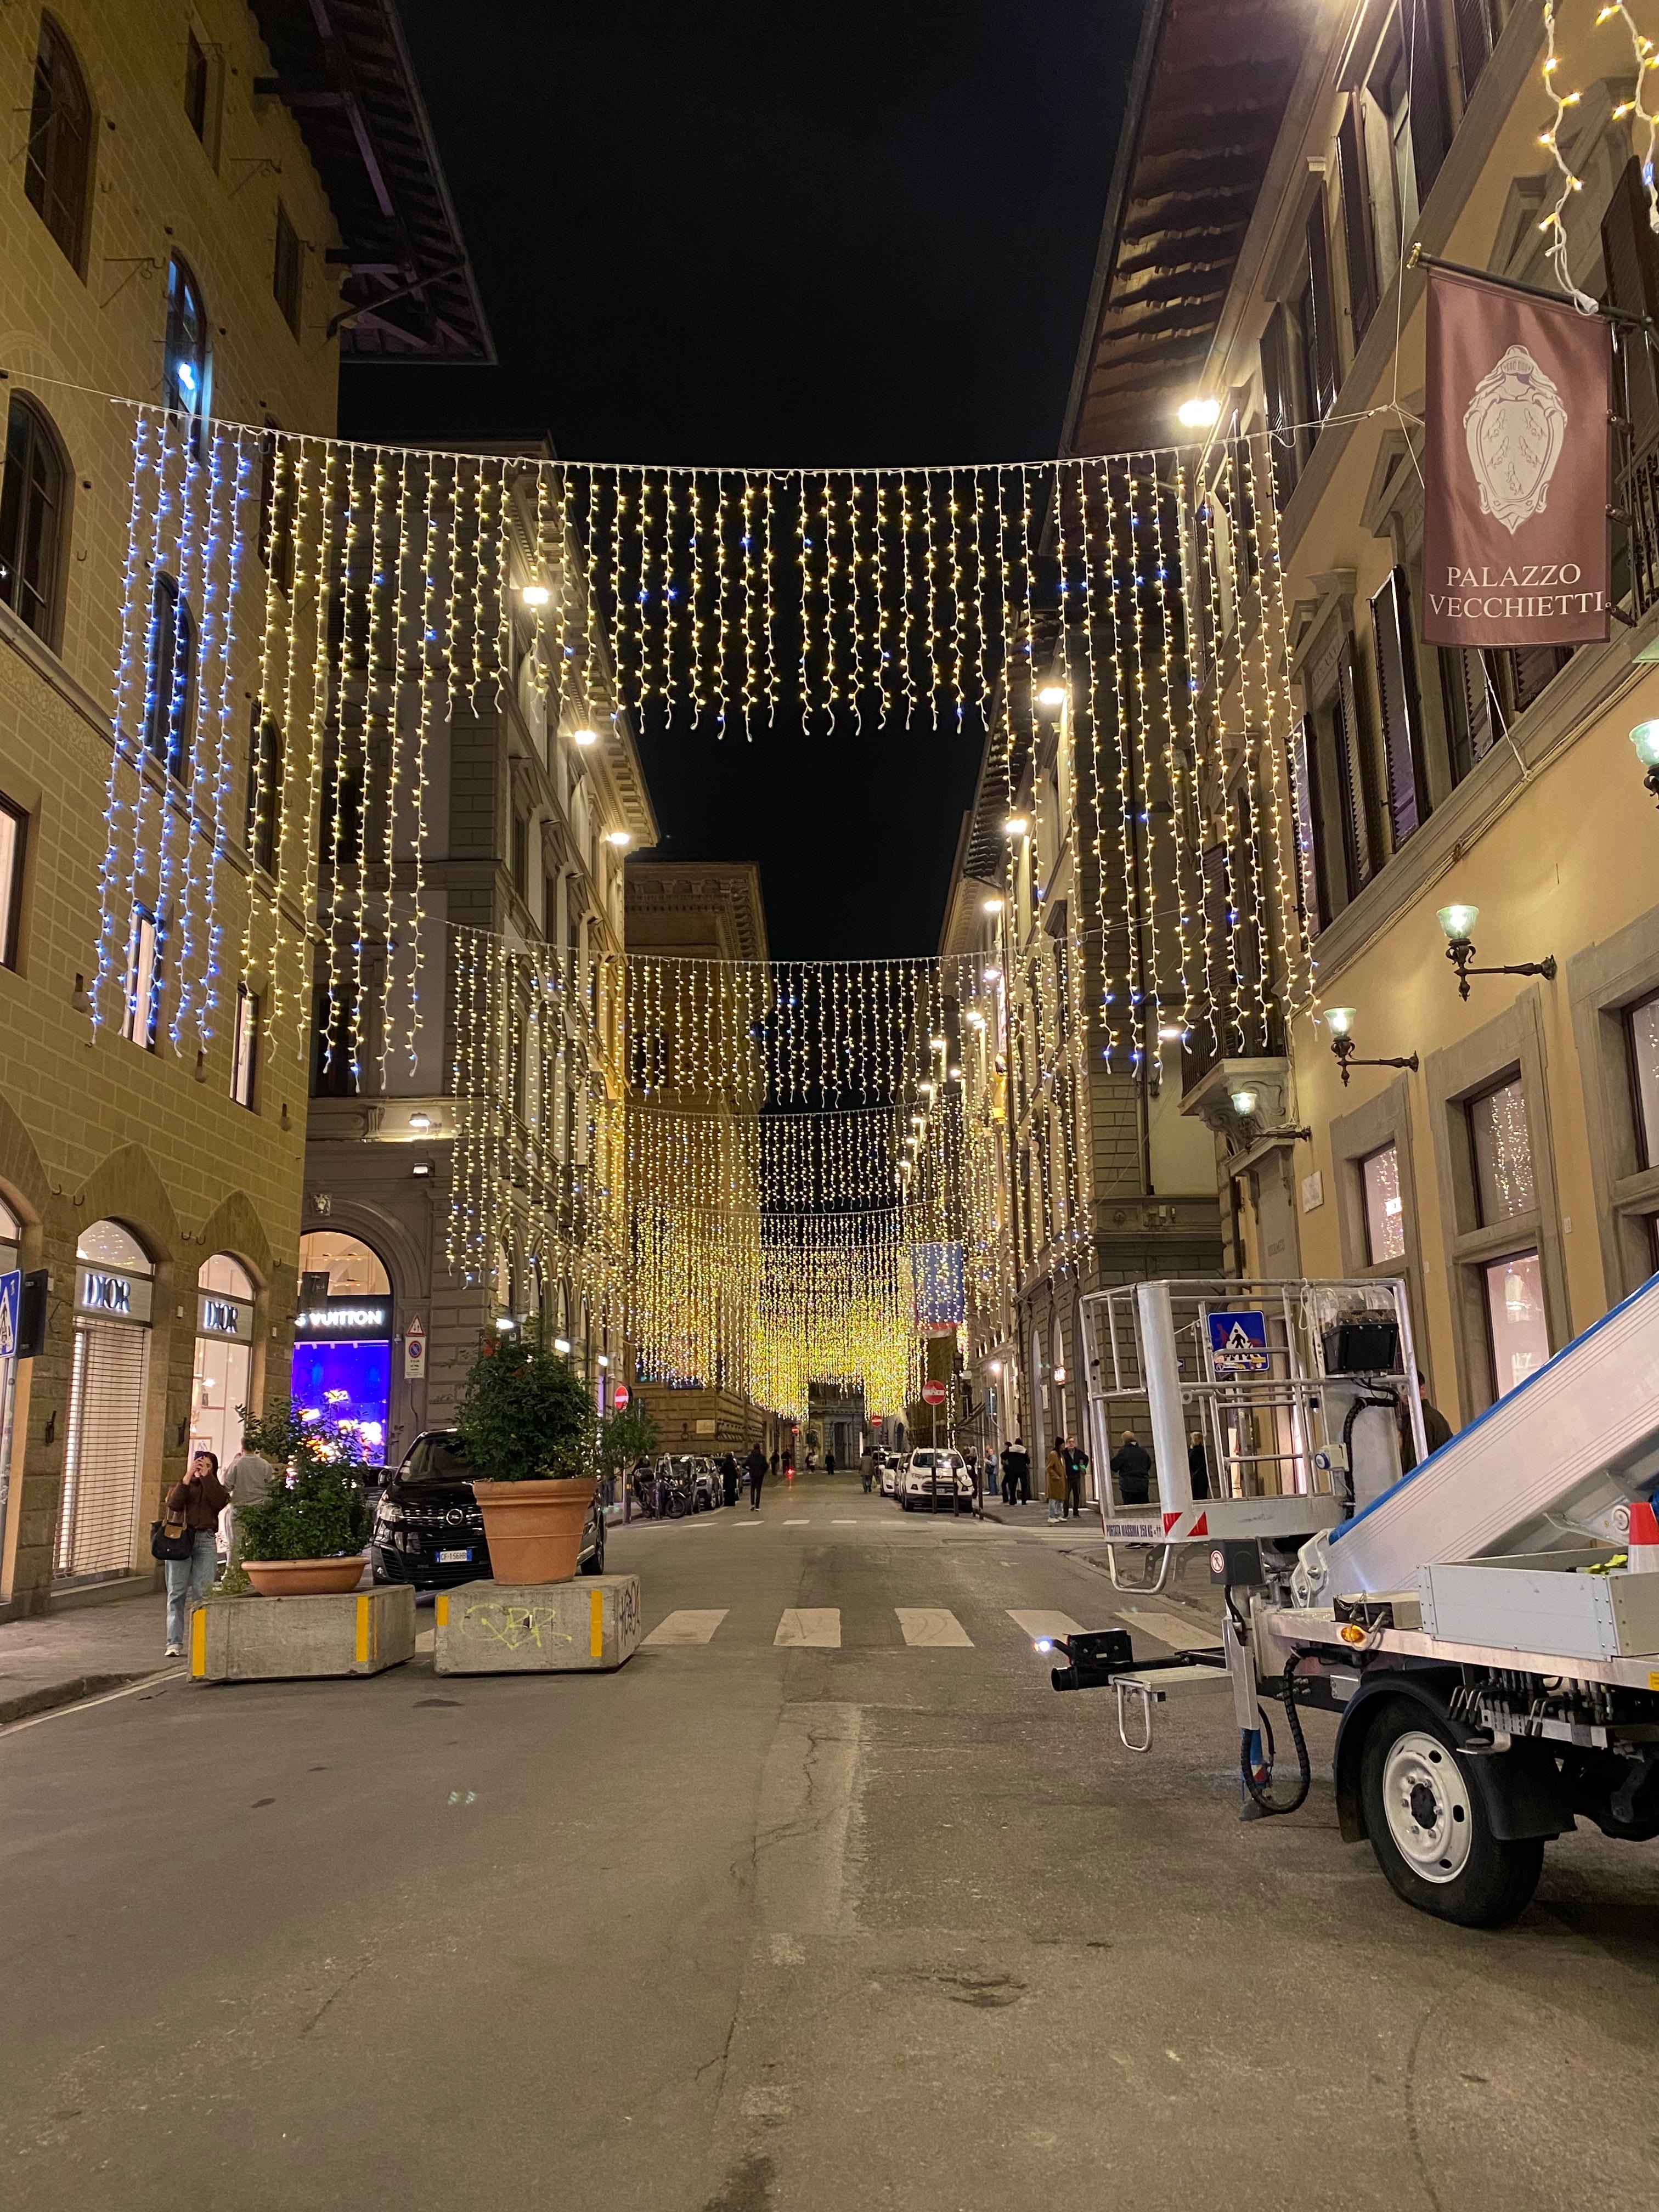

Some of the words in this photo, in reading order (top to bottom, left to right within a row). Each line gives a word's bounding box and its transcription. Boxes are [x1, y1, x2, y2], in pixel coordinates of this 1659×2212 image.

[1447, 563, 1581, 587] PALAZZO
[1429, 591, 1604, 618] VECCHIETTI
[83, 1273, 131, 1312] DIOR
[204, 1300, 238, 1333] DIOR
[309, 1310, 382, 1326] VUITTON
